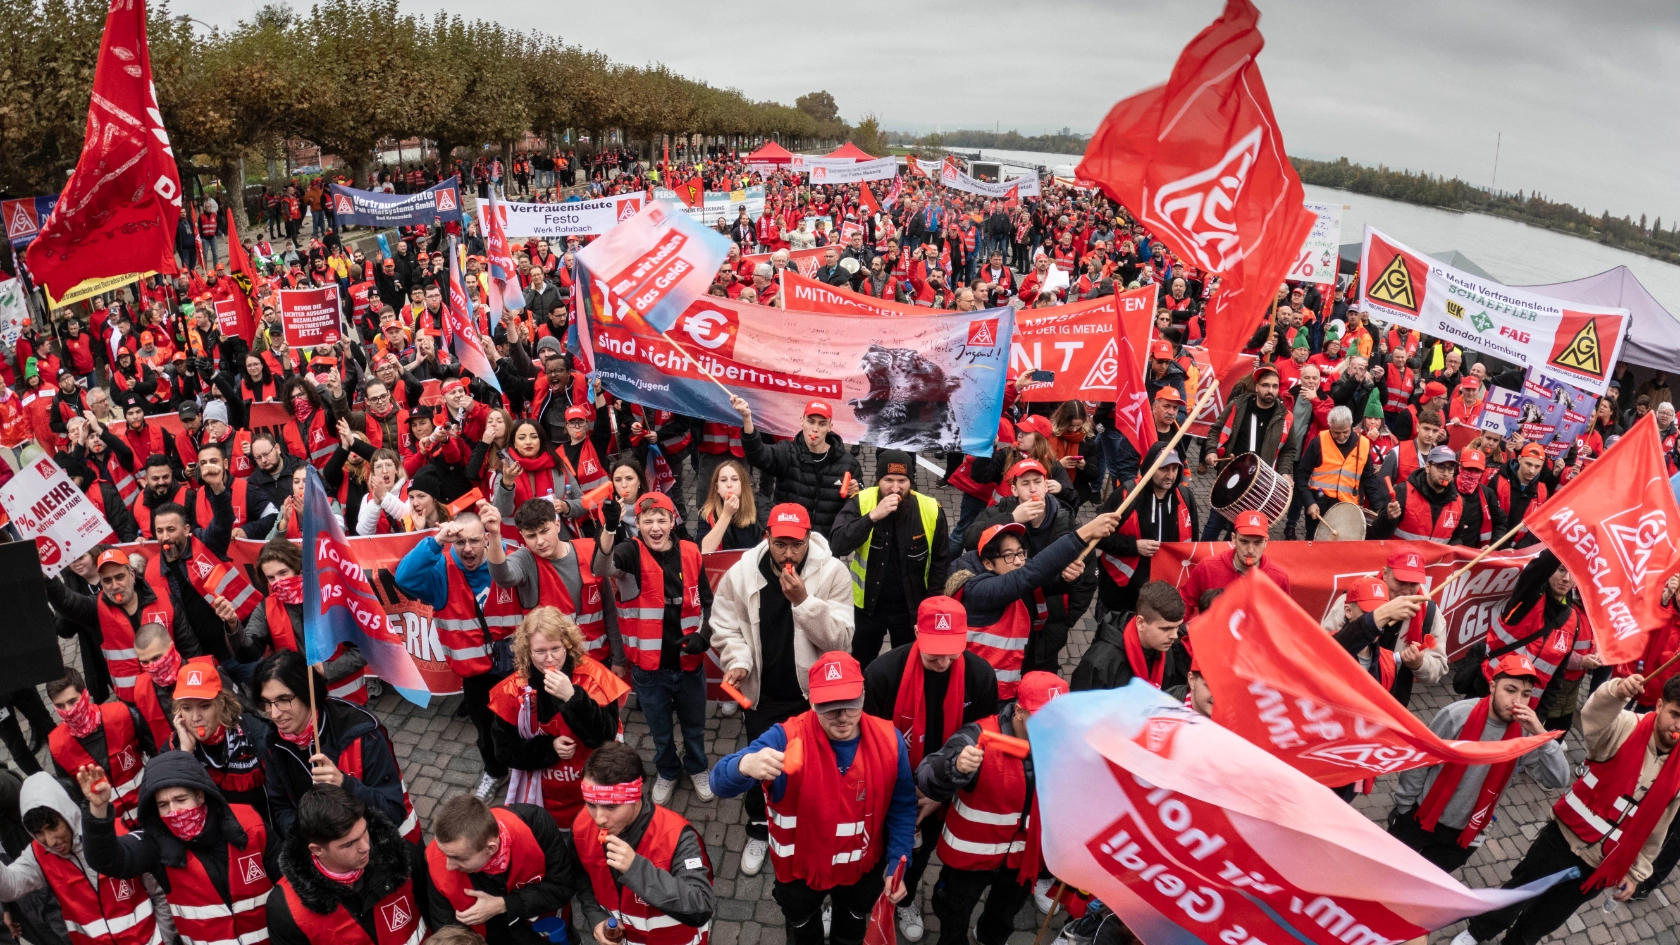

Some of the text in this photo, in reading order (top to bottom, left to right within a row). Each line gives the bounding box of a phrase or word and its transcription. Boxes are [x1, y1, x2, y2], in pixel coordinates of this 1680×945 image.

[415, 200, 436, 210] GmbH
[510, 200, 613, 213] Vertrauensleute
[533, 225, 593, 234] Werk Rohrbach
[544, 213, 580, 225] Festo
[631, 234, 684, 278] wir holen
[62, 285, 93, 301] ertrauensleute
[611, 279, 638, 296] mm,
[635, 260, 690, 310] das Geld!
[1446, 272, 1476, 291] Metall
[1478, 285, 1560, 314] Vertrauensleute
[795, 285, 904, 317] MITMACHEN
[1024, 296, 1147, 328] MITGESTALEN
[1448, 284, 1538, 322] SCHAEFFLER
[288, 319, 334, 330] INDUSTRIESTROM
[292, 315, 330, 323] BEZAHLBARER
[1035, 324, 1114, 335] DER IG METALL
[298, 328, 322, 338] JETZT.
[1438, 321, 1527, 362] Standort Homburg
[1499, 325, 1531, 344] FAG
[598, 332, 636, 356] sind
[640, 345, 694, 372] nicht
[697, 355, 838, 394] übertrieben!
[1545, 364, 1602, 387] HOMBURG-SAARPFALZ
[1485, 402, 1519, 416] Wir fordern:
[1484, 420, 1499, 430] 170
[30, 480, 76, 522] MEHR
[36, 494, 83, 534] NÖTIG UND FAIR!
[1551, 506, 1641, 641] AISERSLAUTERN
[346, 597, 382, 630] das
[1457, 598, 1510, 645] GEW
